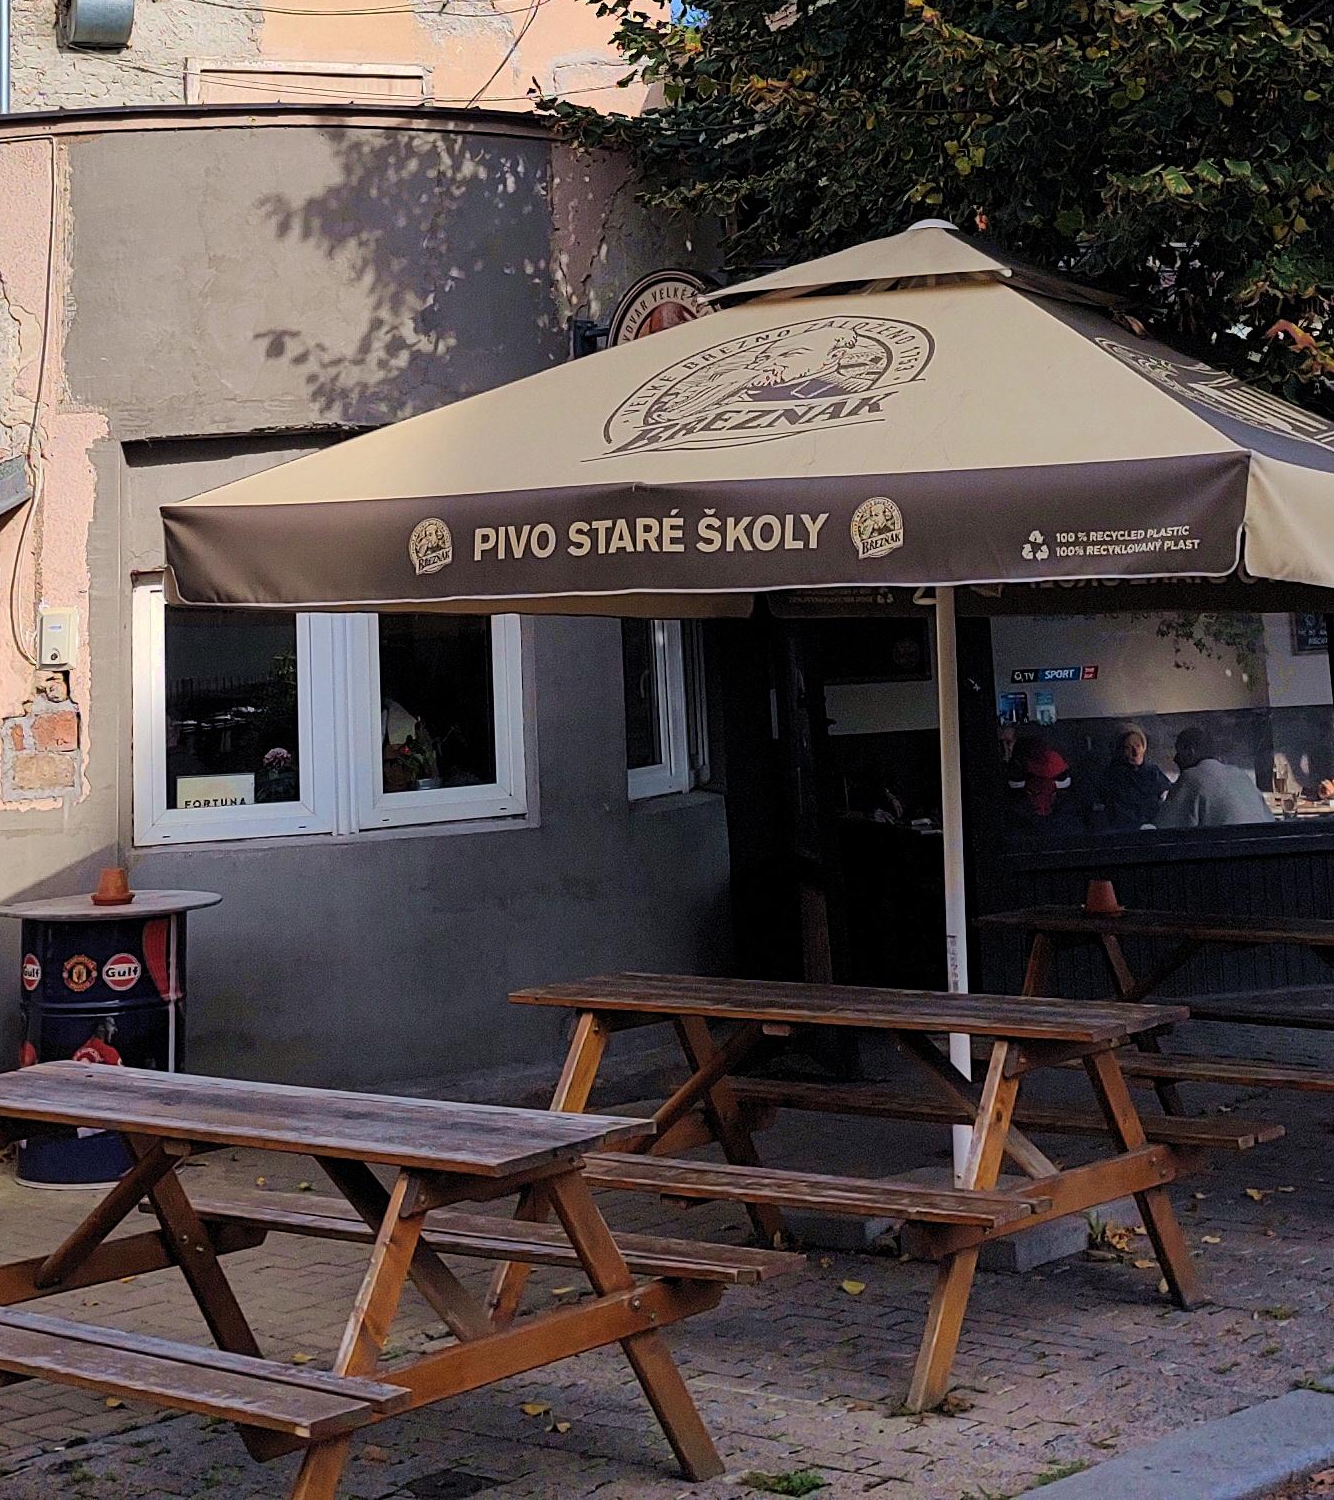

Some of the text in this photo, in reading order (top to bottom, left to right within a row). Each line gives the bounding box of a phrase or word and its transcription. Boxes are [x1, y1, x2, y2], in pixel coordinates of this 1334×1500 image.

[473, 508, 830, 561] PIVO STARÉ ŠKOLY
[1056, 532, 1075, 543] 100
[1090, 529, 1145, 543] RECYCLED
[1147, 526, 1190, 539] PLASTIC
[1056, 539, 1201, 557] 100% RECYKLOVANÝ PLAST
[1044, 669, 1075, 679] SPORT
[184, 797, 247, 809] FORTUNA
[105, 967, 139, 978] Gulf
